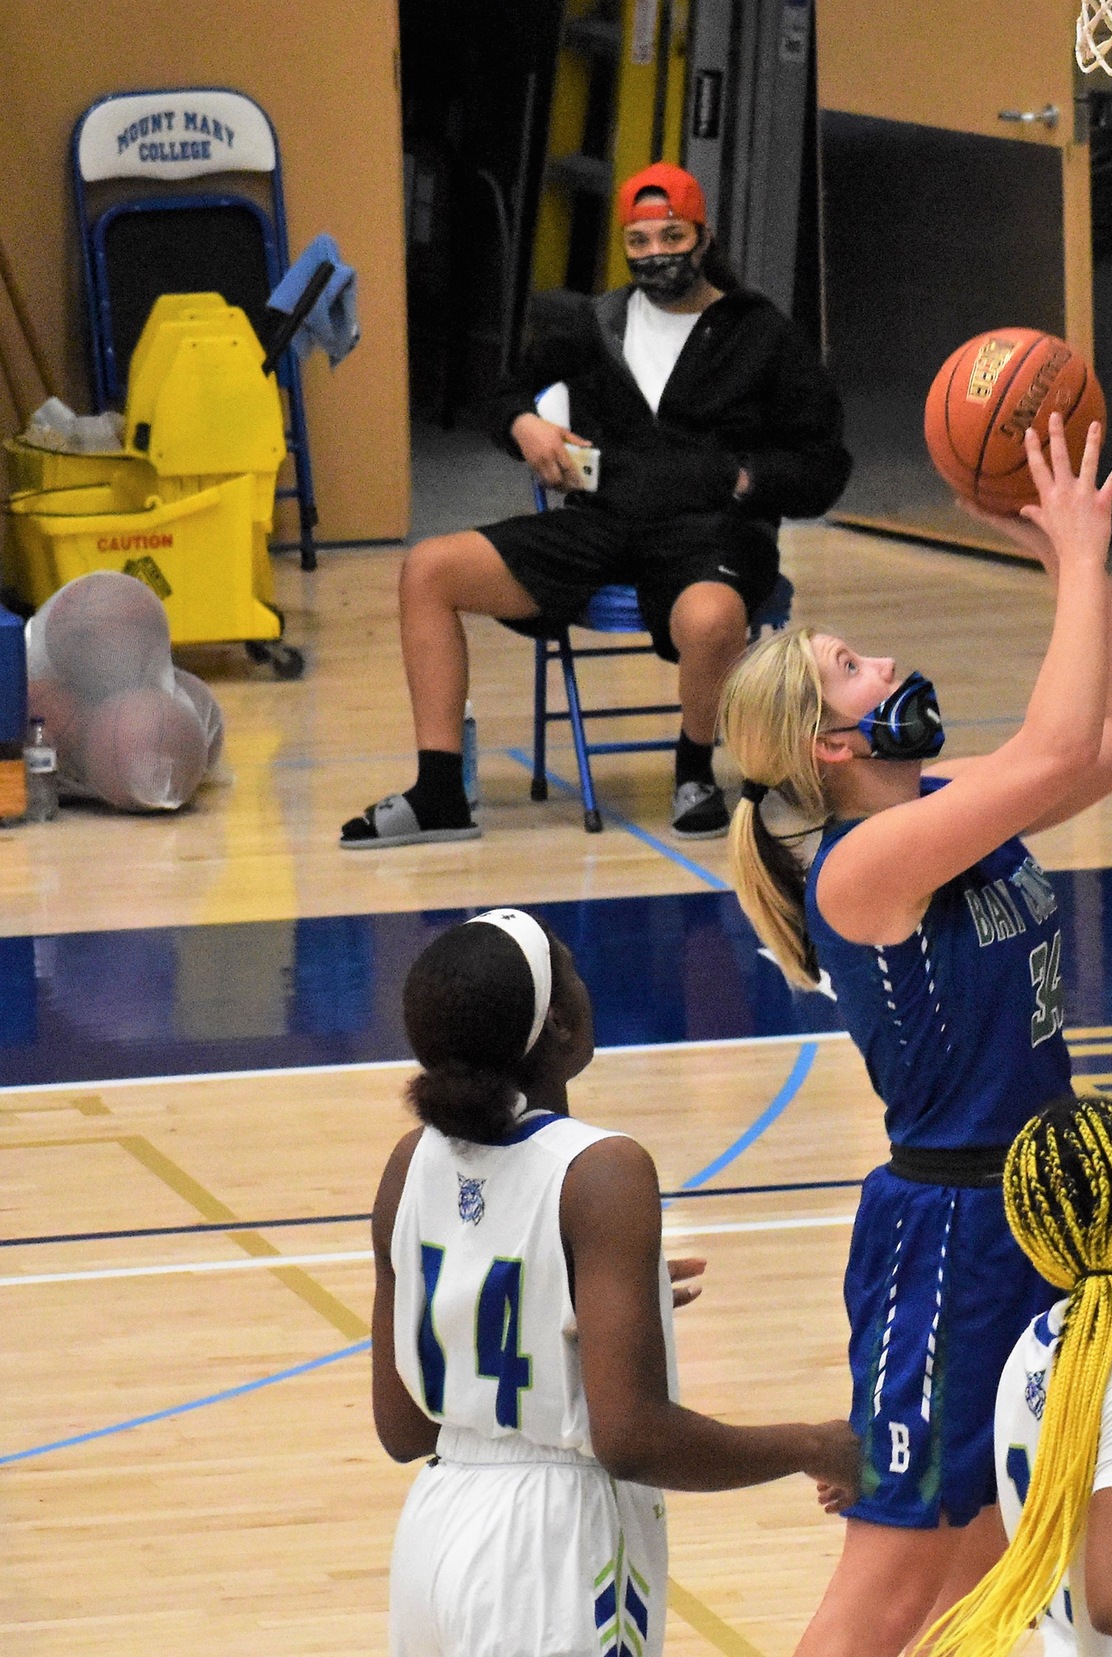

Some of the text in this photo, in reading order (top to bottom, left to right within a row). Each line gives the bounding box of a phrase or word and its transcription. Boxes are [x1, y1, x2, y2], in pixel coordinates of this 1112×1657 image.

[117, 111, 235, 155] MOUNT MARY
[138, 141, 212, 162] COLLEGE
[97, 534, 174, 552] CAUTION
[418, 1240, 533, 1431] 14
[888, 1421, 910, 1474] B
